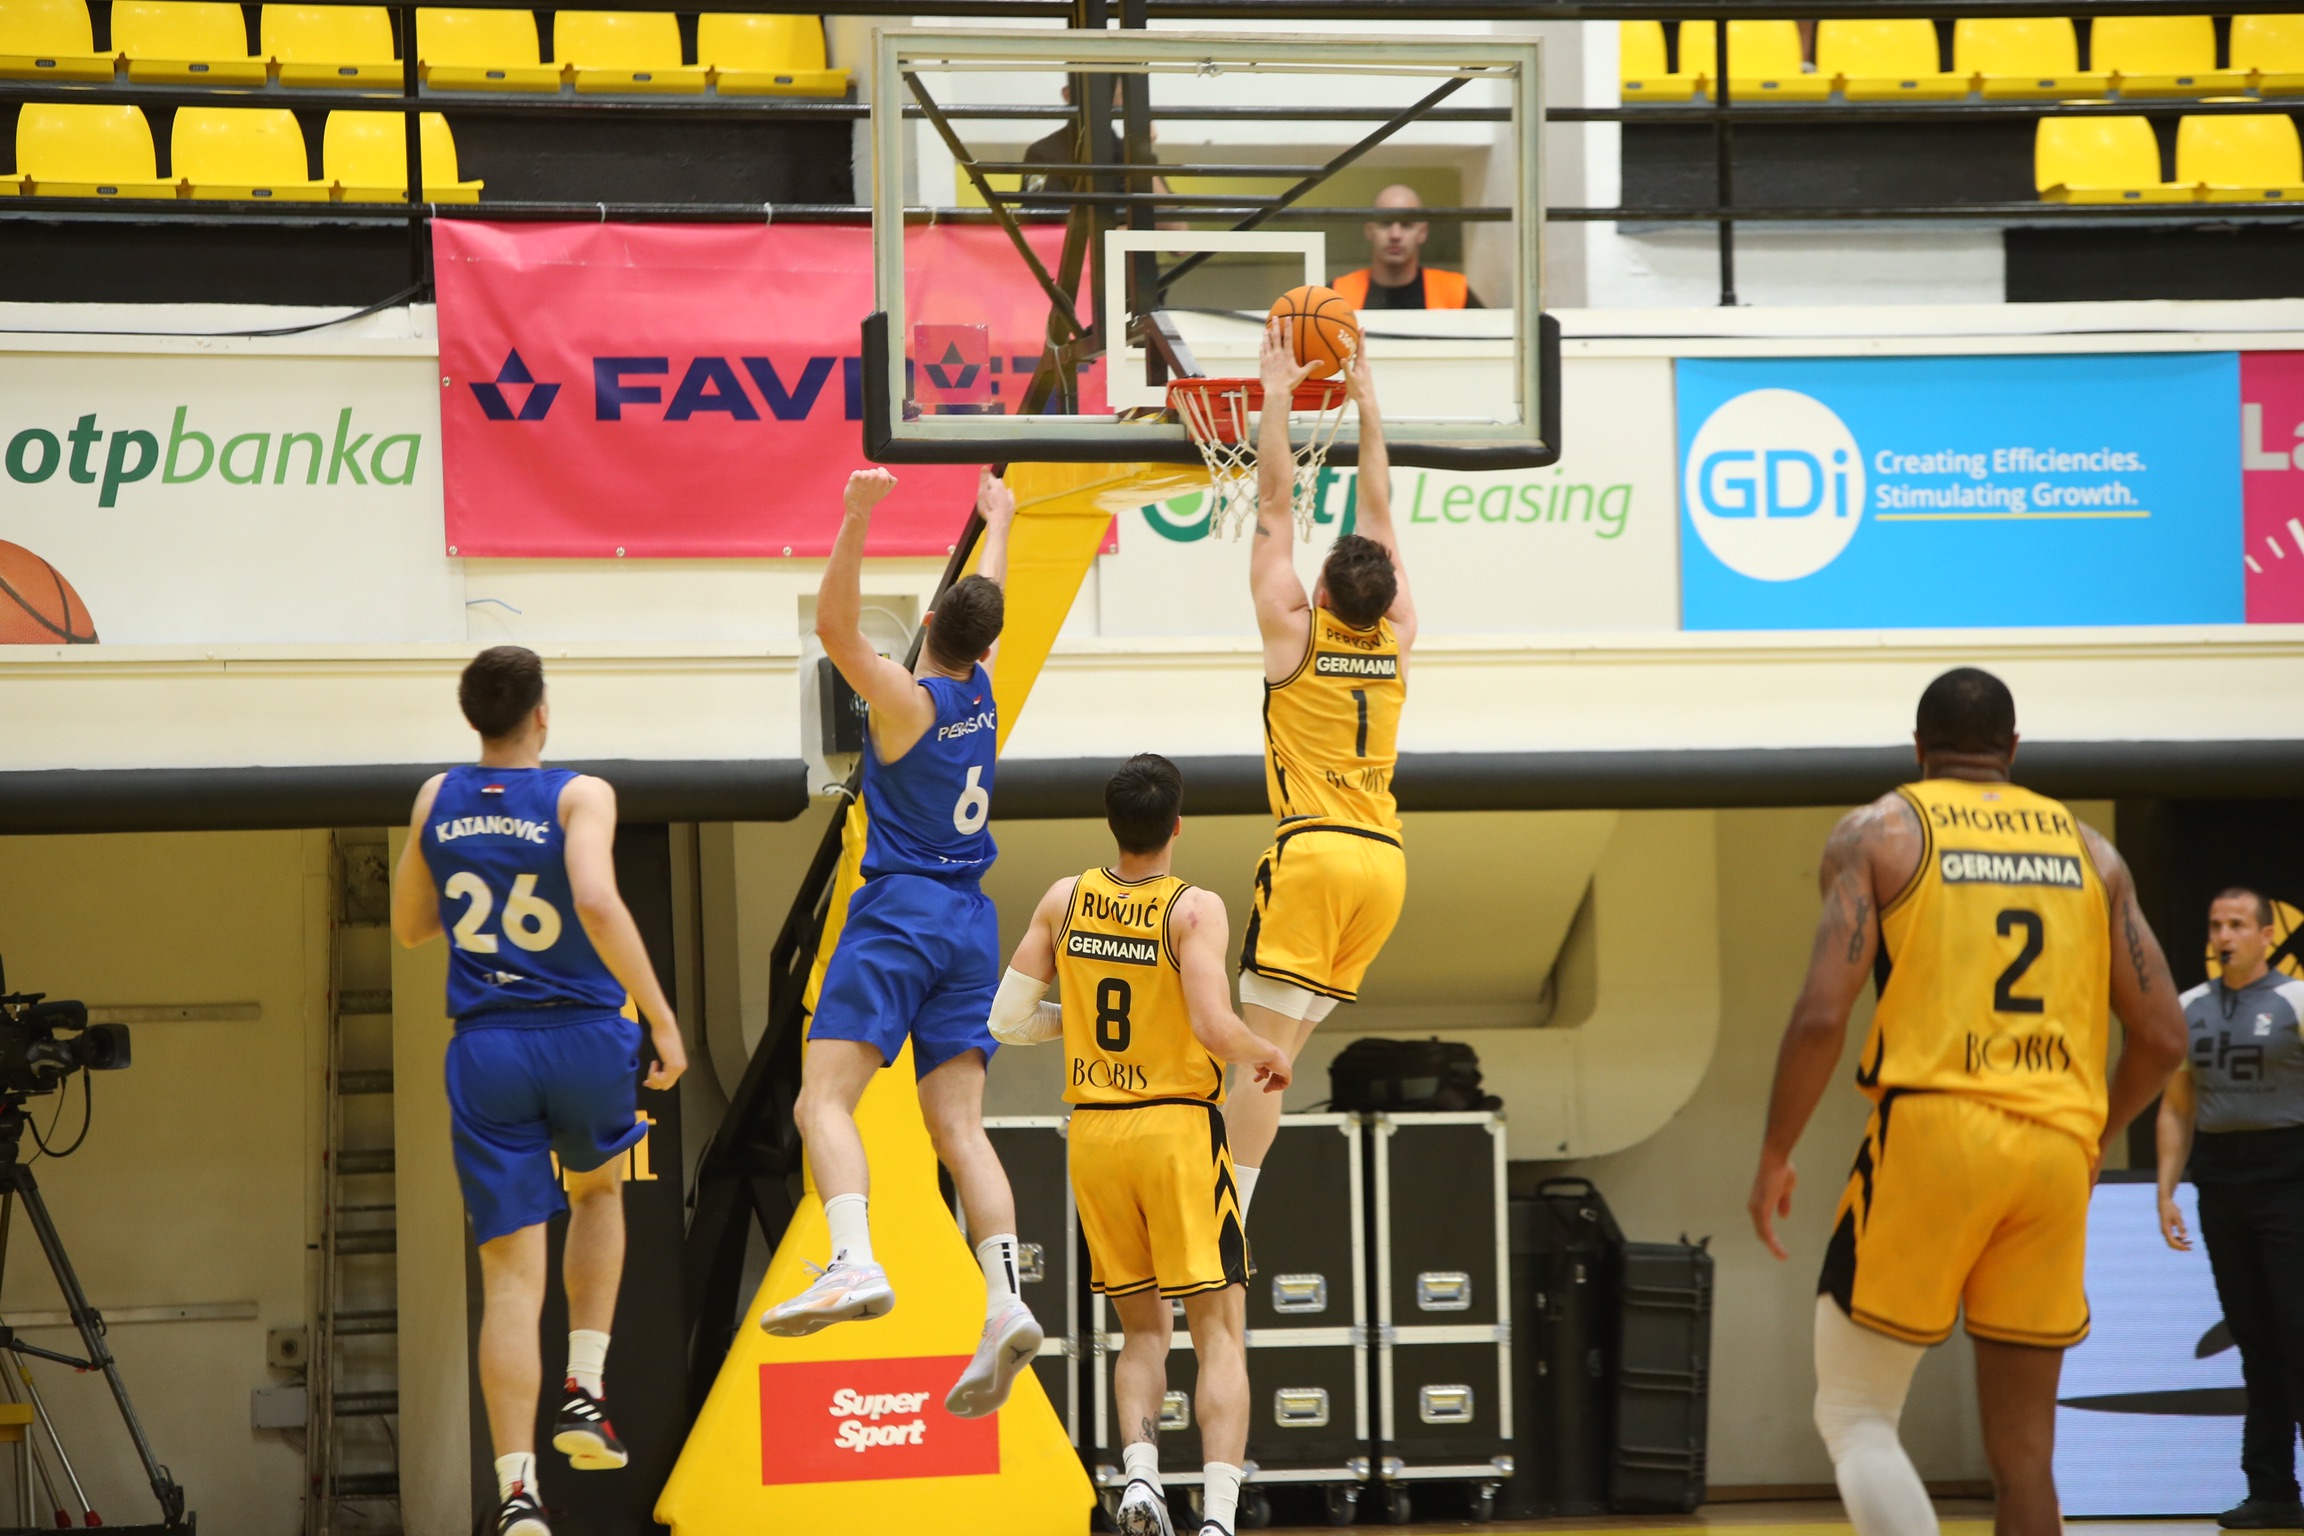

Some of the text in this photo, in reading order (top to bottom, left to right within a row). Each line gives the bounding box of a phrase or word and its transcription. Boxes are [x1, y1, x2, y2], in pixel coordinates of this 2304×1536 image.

[5, 405, 422, 508] otpbanka
[1875, 448, 2147, 480] Creating Efficiencies.
[1699, 449, 1848, 518] GDi
[1875, 481, 2139, 513] Stimulating Growth.
[1410, 467, 1633, 540] Leasing
[1316, 656, 1396, 675] GERMANIA
[1350, 689, 1369, 758] 1
[953, 765, 989, 836] 6
[435, 815, 550, 844] KATANOVIĆ
[1931, 803, 2073, 837] SHORTER
[1942, 853, 2082, 885] GERMANIA
[444, 871, 562, 953] 26
[1081, 892, 1158, 928] RUNJIĆ
[1069, 935, 1156, 961] GERMANIA
[1993, 909, 2044, 1014] 2
[1096, 977, 1131, 1052] 8
[1965, 1030, 2070, 1076] BOBIS
[1073, 1057, 1148, 1090] BOBIS
[829, 1388, 930, 1420] Super
[834, 1419, 926, 1453] Sport
